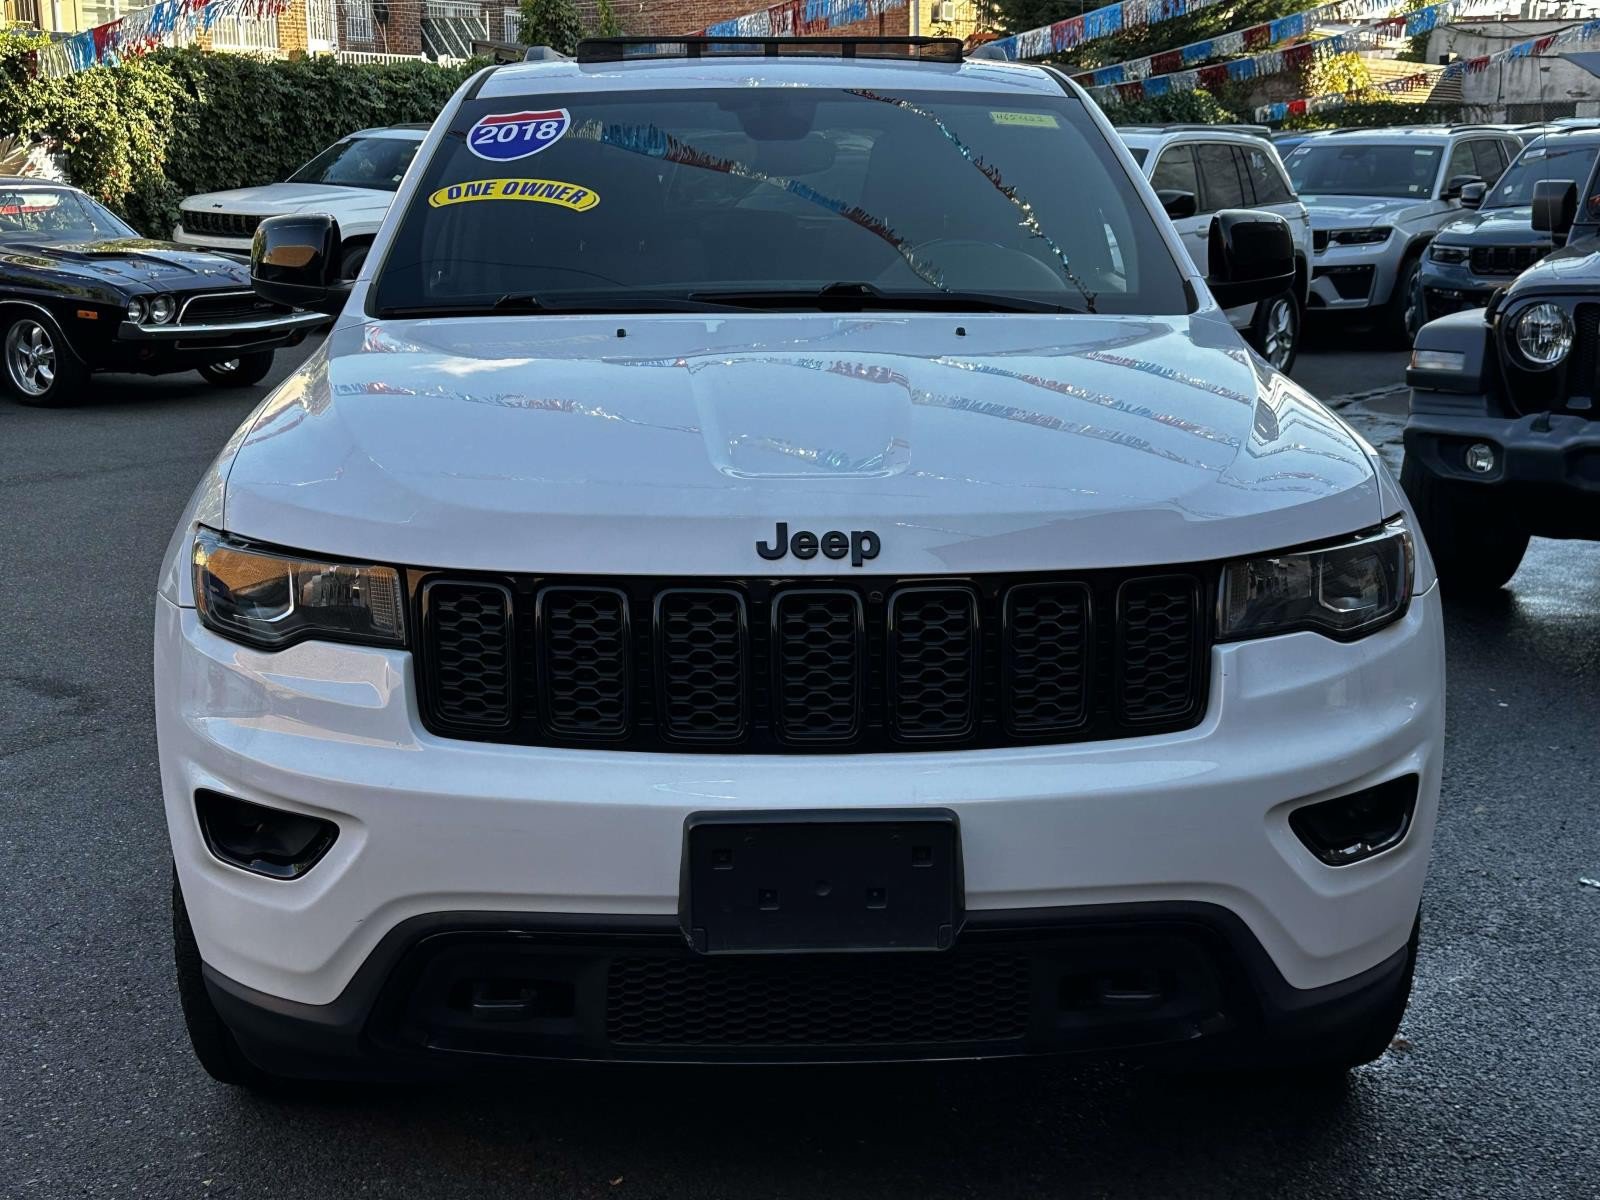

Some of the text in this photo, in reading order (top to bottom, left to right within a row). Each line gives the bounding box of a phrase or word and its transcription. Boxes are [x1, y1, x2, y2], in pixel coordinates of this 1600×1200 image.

[474, 122, 558, 144] 2018
[447, 181, 588, 205] ONE OWNER
[756, 522, 881, 567] Jeep
